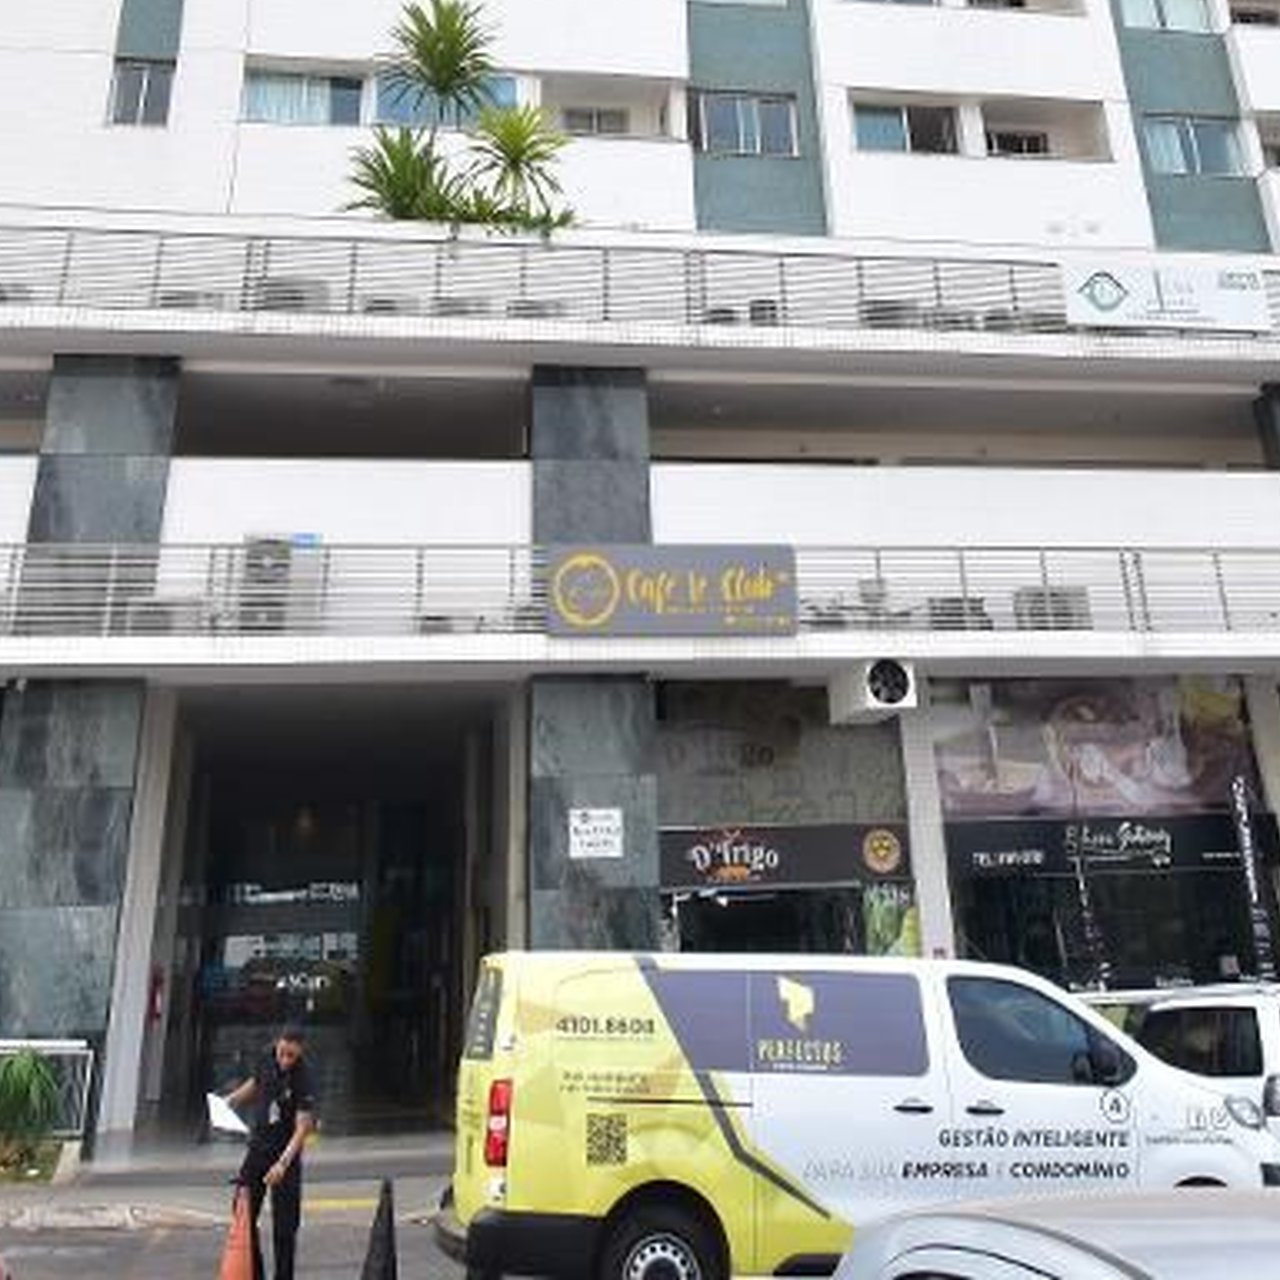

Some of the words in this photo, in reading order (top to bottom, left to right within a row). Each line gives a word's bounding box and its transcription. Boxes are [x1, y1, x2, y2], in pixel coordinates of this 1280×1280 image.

[938, 1126, 1008, 1148] GESTÃO
[1011, 1128, 1129, 1148] INTELIGENTE
[901, 1161, 988, 1180] EMPRESA
[1009, 1160, 1129, 1180] CONDOMÍNIO
